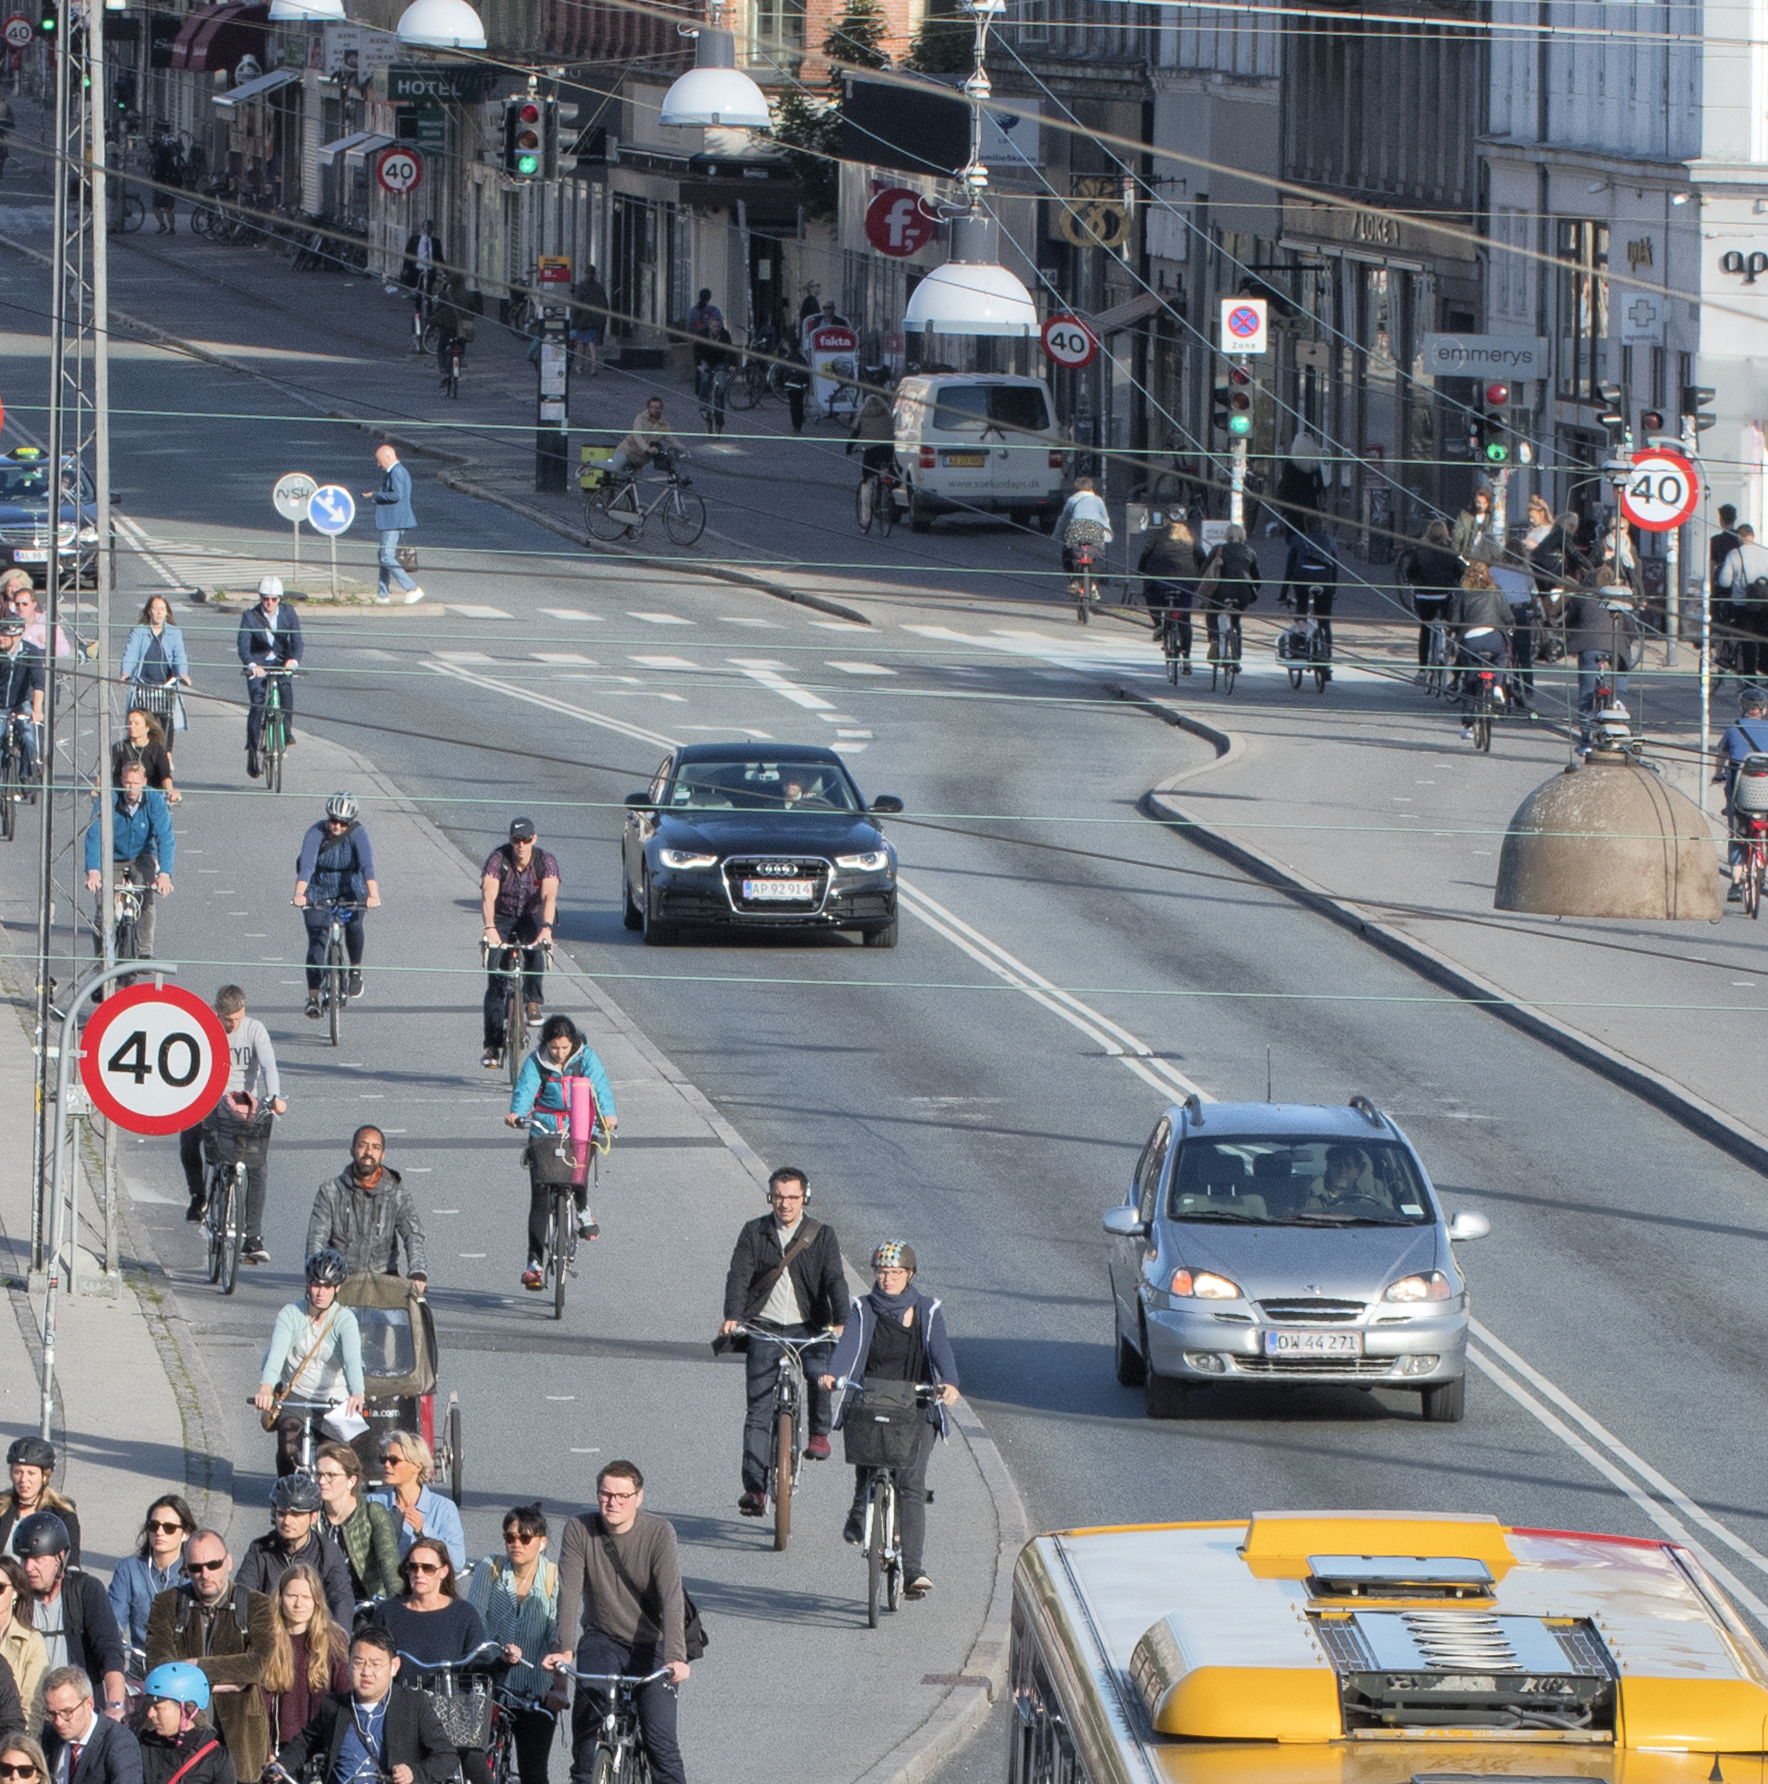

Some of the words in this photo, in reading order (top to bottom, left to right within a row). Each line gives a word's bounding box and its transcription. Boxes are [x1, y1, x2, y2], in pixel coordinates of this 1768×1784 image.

[8, 25, 32, 41] 40
[397, 79, 461, 96] HOTEL
[385, 163, 413, 181] 40
[820, 336, 851, 347] fakta
[1051, 332, 1085, 353] 40
[1232, 341, 1257, 350] Zone
[1438, 346, 1534, 366] emmerys
[1630, 475, 1681, 505] 40
[752, 882, 767, 895] AP
[771, 882, 786, 895] 92
[788, 882, 810, 895] 914
[107, 1030, 201, 1086] 40
[1304, 1336, 1324, 1349] 44
[1328, 1336, 1356, 1350] 271
